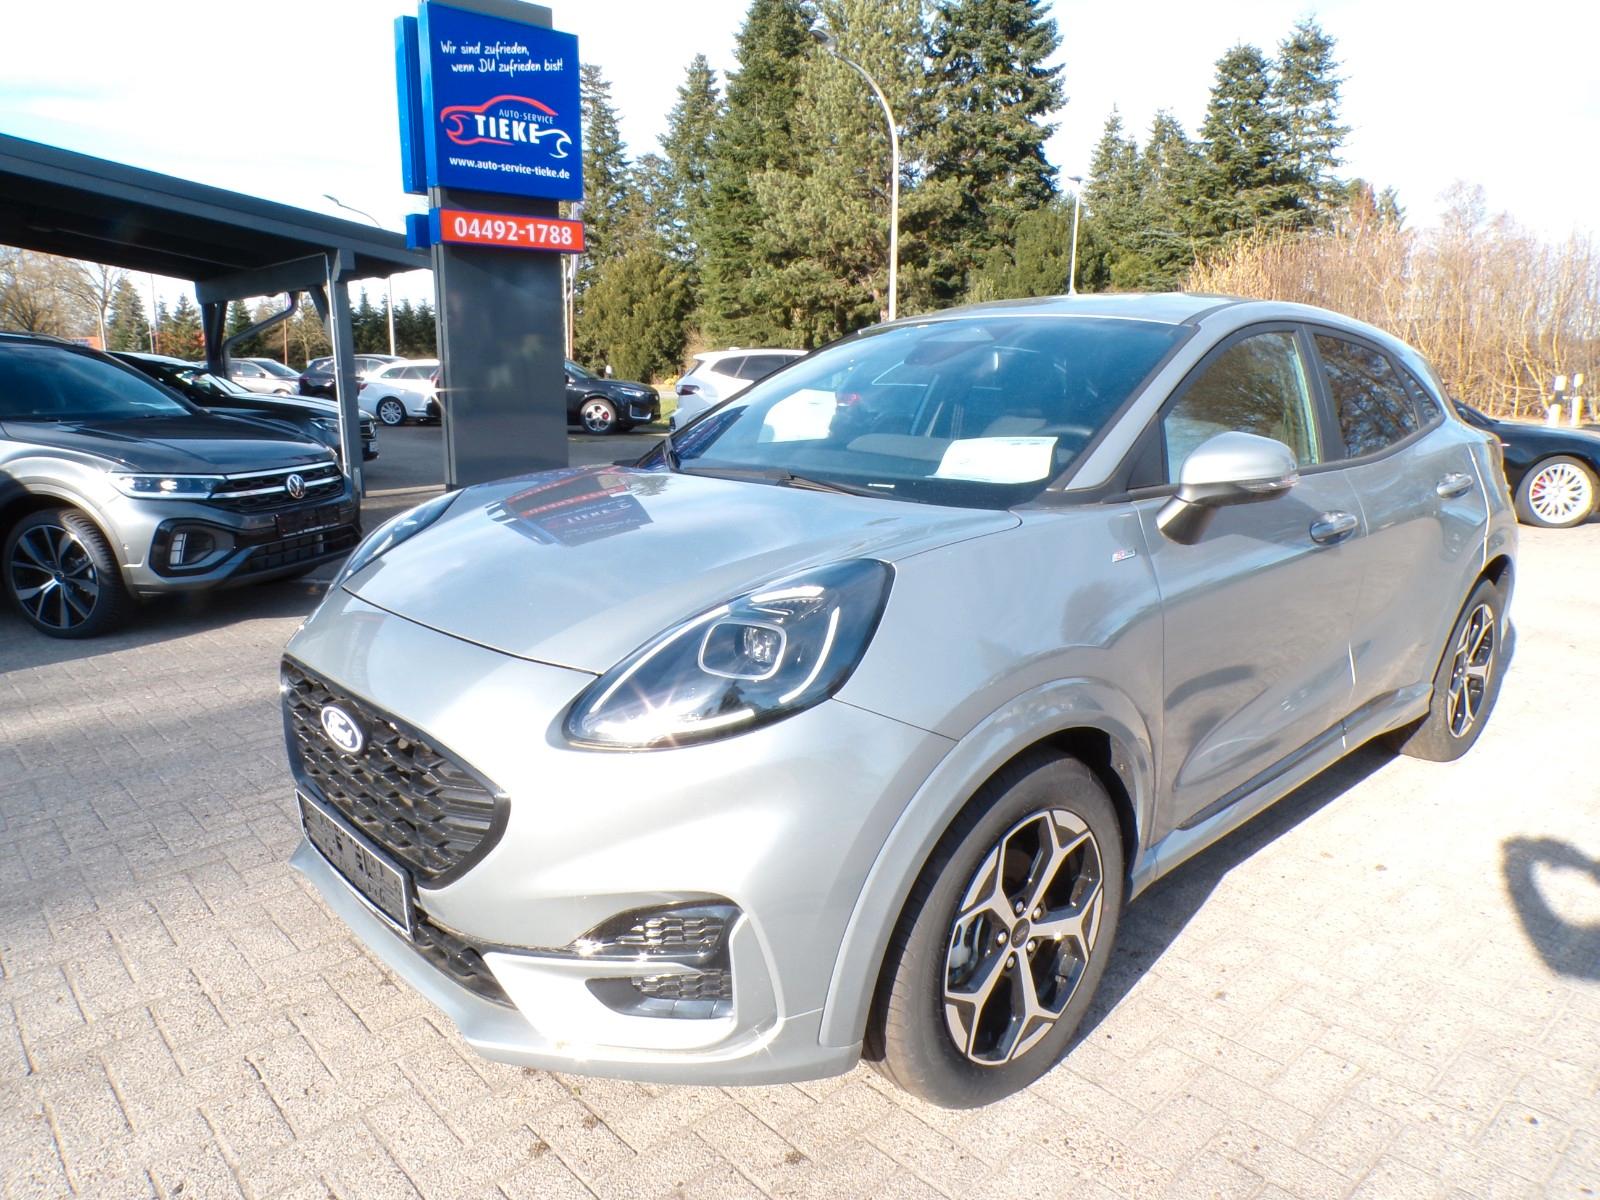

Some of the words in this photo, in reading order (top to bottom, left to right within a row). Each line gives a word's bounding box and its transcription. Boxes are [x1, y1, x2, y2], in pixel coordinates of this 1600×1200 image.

[440, 40, 456, 55] Wir
[461, 41, 481, 55] sind
[484, 41, 529, 60] zufrieden,
[451, 63, 475, 73] wenn
[478, 58, 496, 73] DU
[498, 58, 541, 77] zufrieden
[544, 58, 564, 72] bist!
[499, 109, 554, 124] AUTO-SERVICE
[474, 114, 541, 144] TIEKE
[449, 157, 570, 179] www.auto-service-tieke.de
[454, 218, 572, 245] 04492-1788
